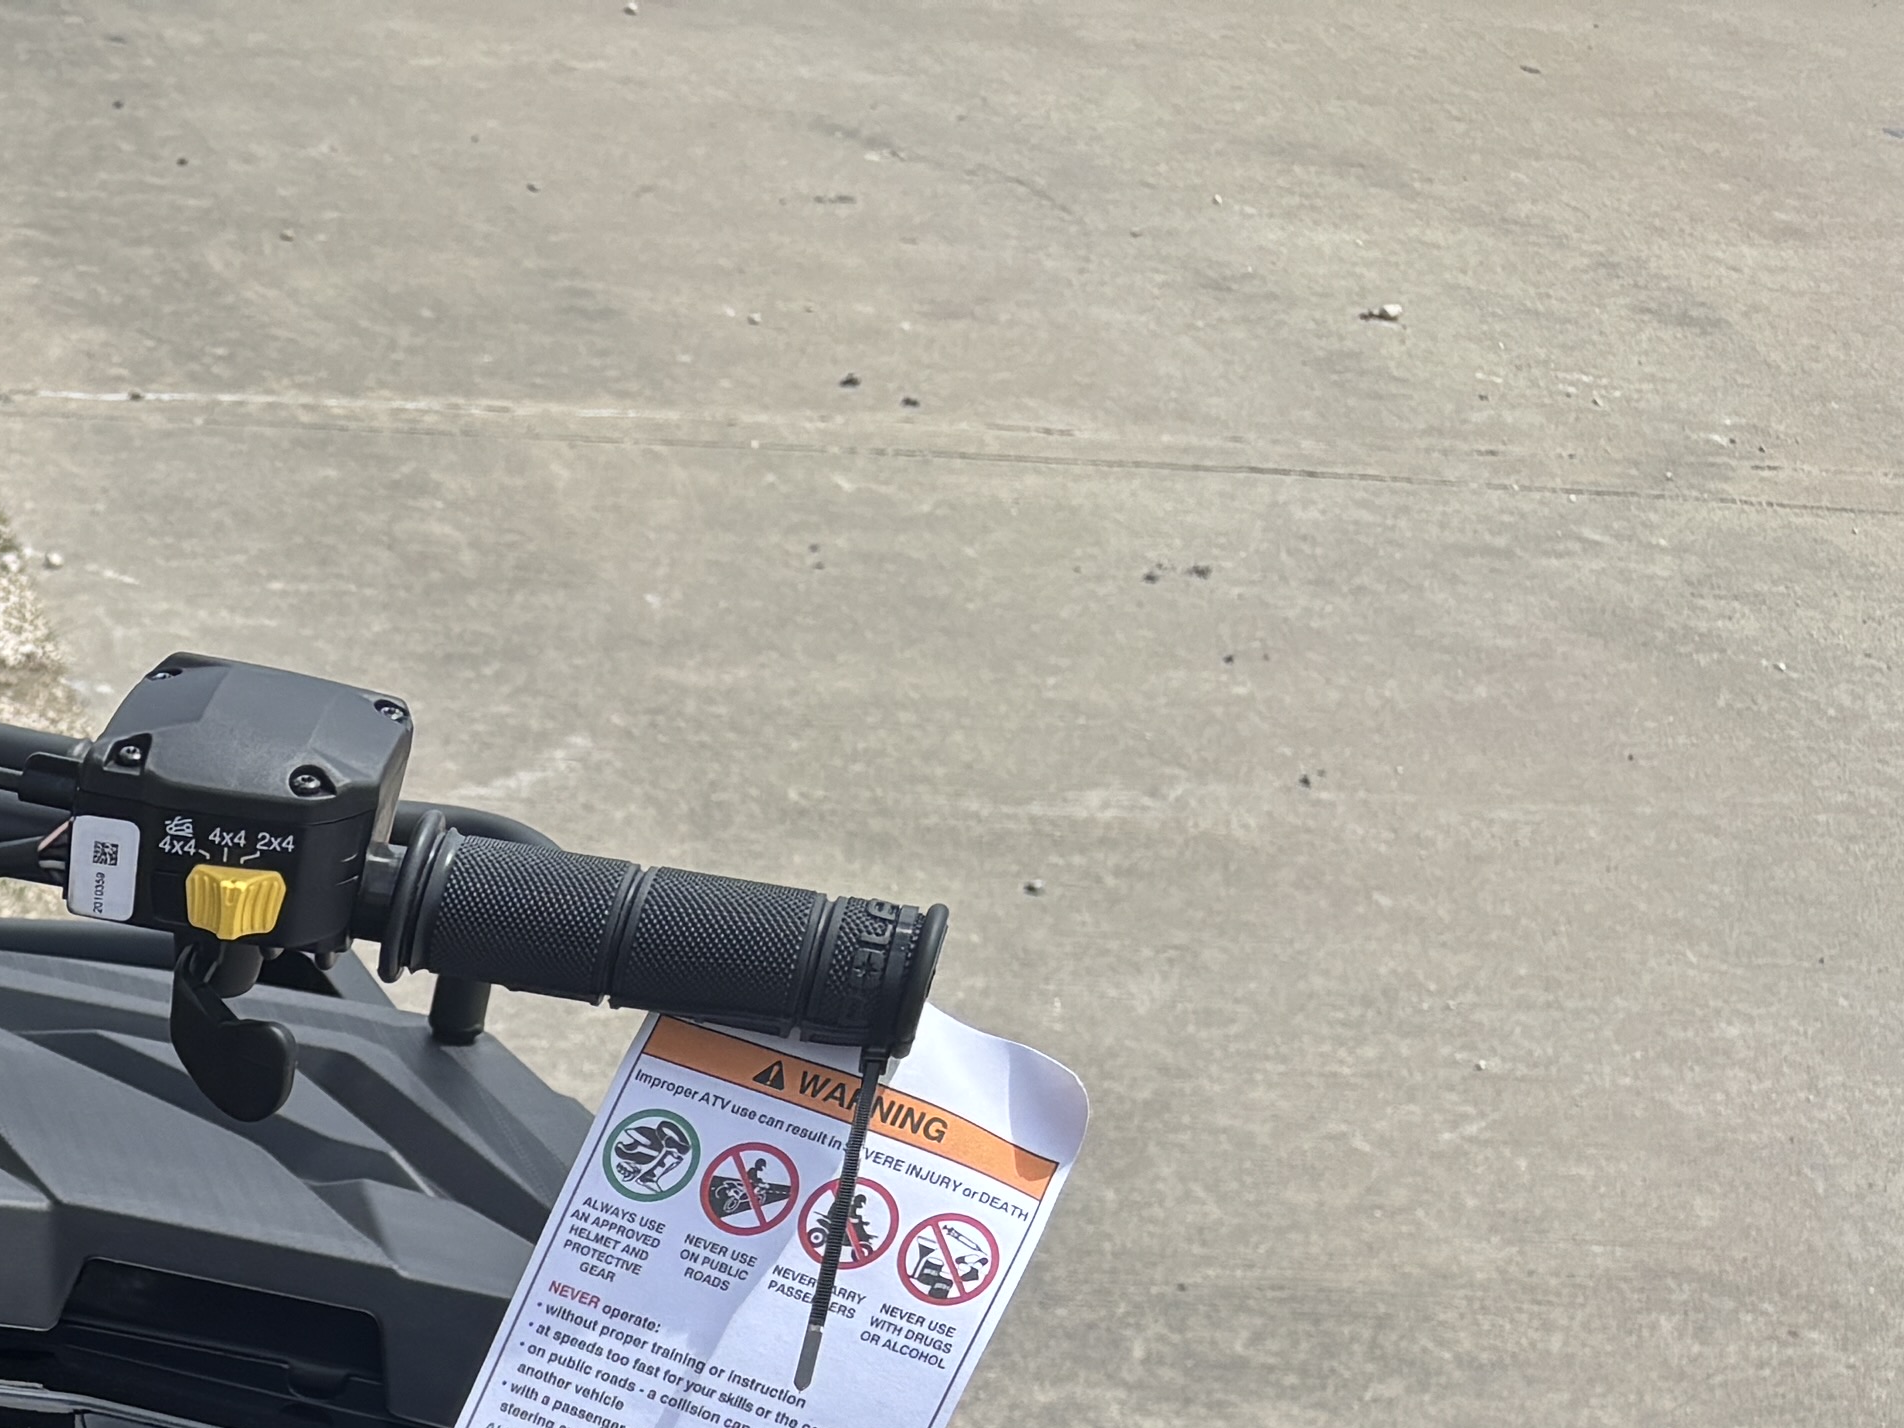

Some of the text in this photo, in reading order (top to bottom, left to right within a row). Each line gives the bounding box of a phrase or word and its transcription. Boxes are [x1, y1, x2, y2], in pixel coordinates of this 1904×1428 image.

[159, 835, 196, 856] 4x4
[208, 827, 295, 852] 4x4 2x4
[632, 1066, 1031, 1222] Improper ATV use can result in VERE INJURY or DEATH
[570, 1207, 661, 1249] AN APPROVED
[582, 1195, 666, 1235] ALWAYS USE
[562, 1237, 642, 1276] PROTECTIVE
[567, 1222, 650, 1262] HELMET AND
[683, 1232, 757, 1268] NEVER USE
[578, 1259, 616, 1283] GEAR
[678, 1247, 749, 1282] ON PUBLIC
[683, 1265, 731, 1292] ROADS
[547, 1280, 662, 1335] NEVER operate:
[767, 1277, 857, 1320] PASSEERS
[815, 1279, 866, 1306] ARRY
[867, 1315, 953, 1355] WITH DRUGS
[879, 1301, 957, 1339] NEVER USE
[543, 1300, 807, 1410] without proper training or instruction
[859, 1329, 948, 1371] OR ALCOHOL
